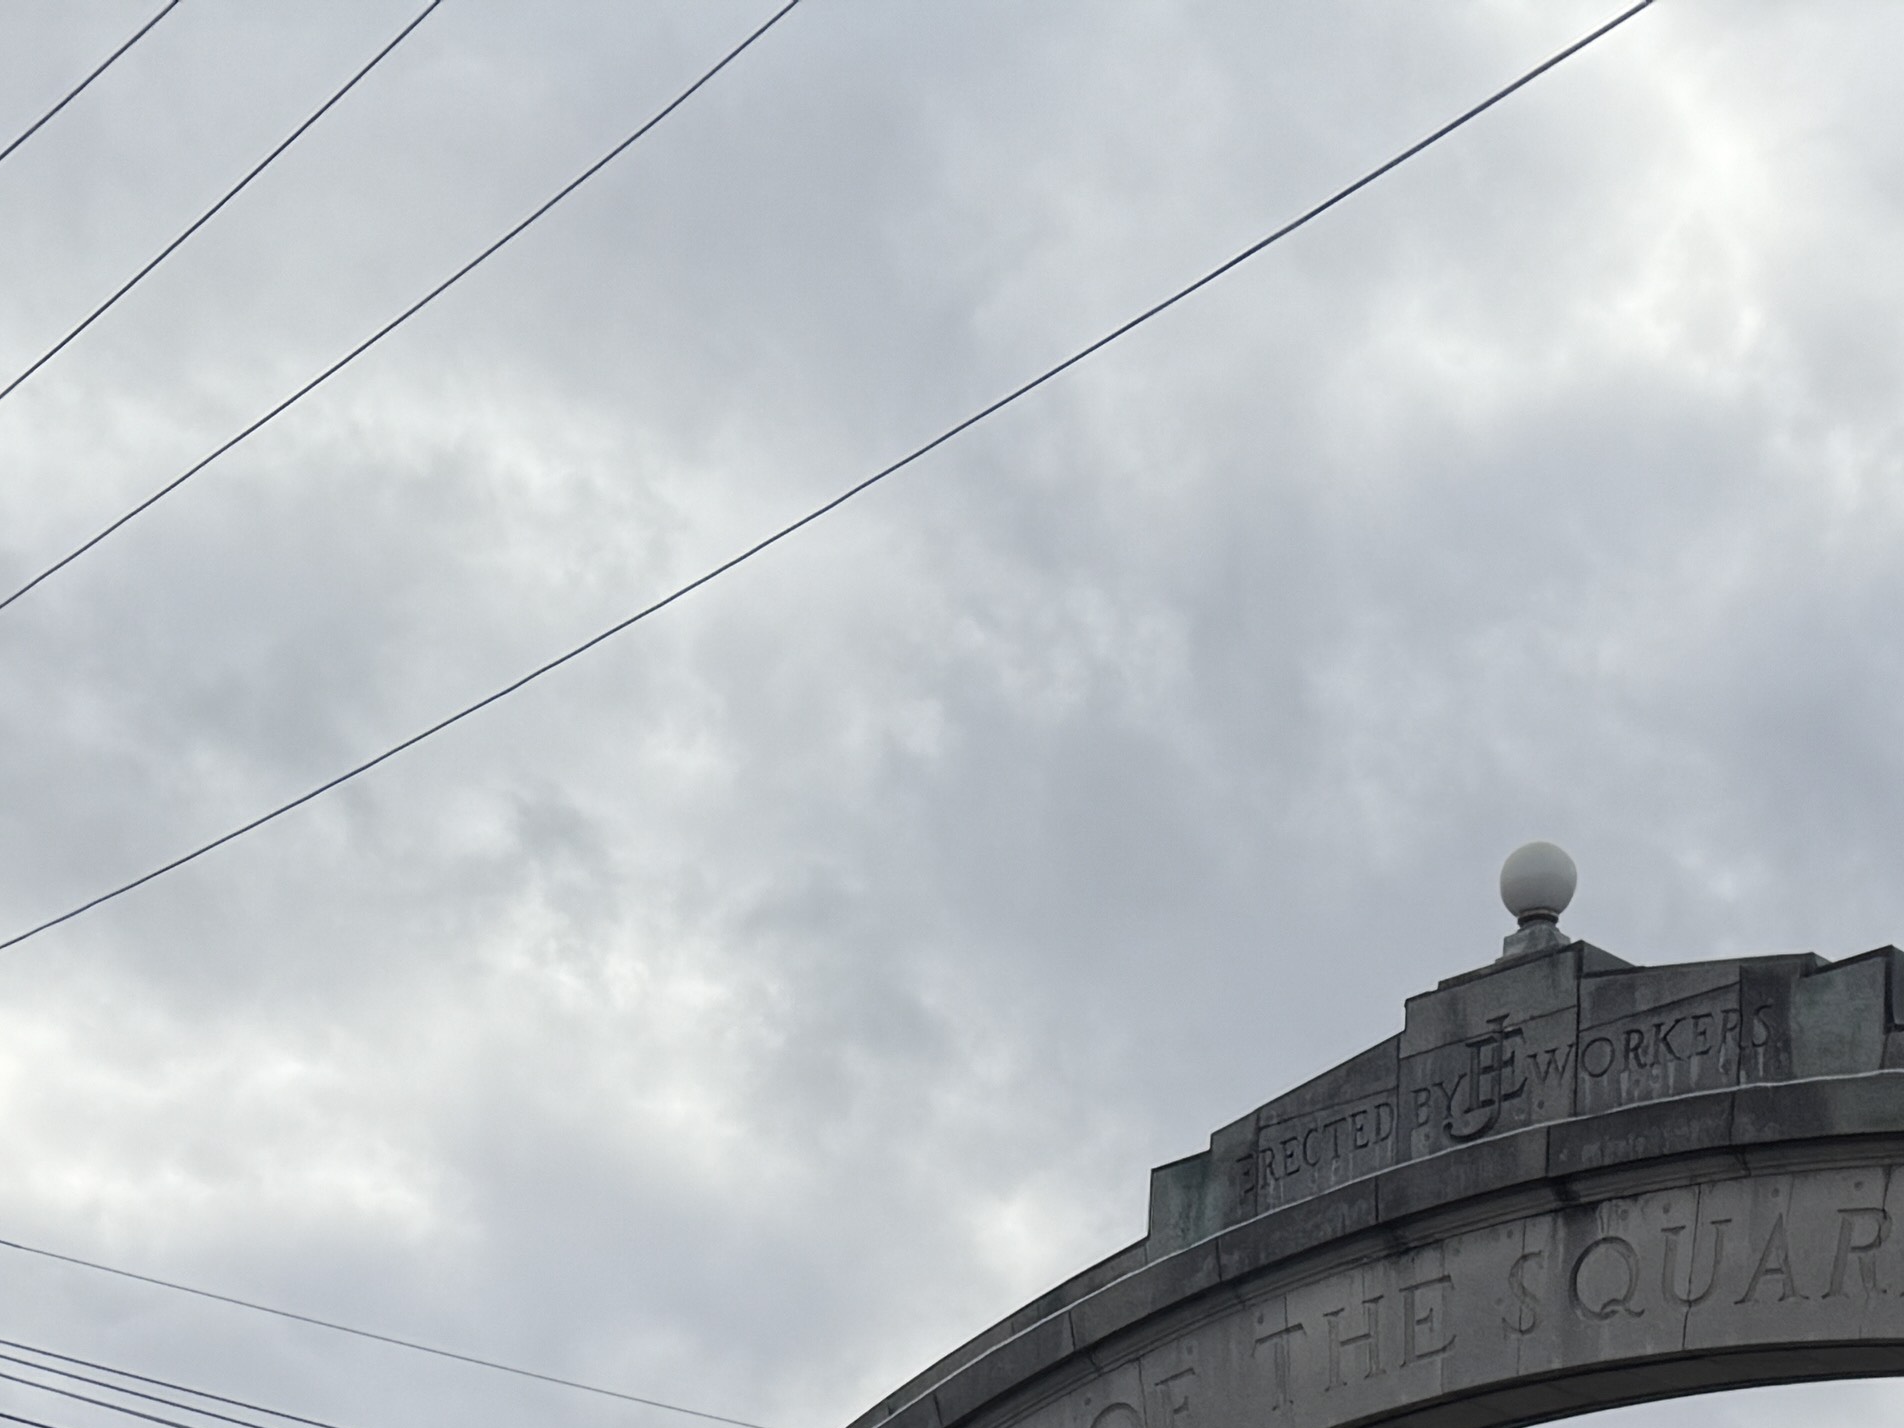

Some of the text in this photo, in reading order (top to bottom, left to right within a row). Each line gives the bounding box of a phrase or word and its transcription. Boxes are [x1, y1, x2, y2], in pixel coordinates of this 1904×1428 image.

[1235, 1102, 1395, 1195] ERECTED
[1410, 1073, 1468, 1129] BY
[1526, 1004, 1773, 1083] WORKERS
[1250, 1273, 1457, 1412] THE
